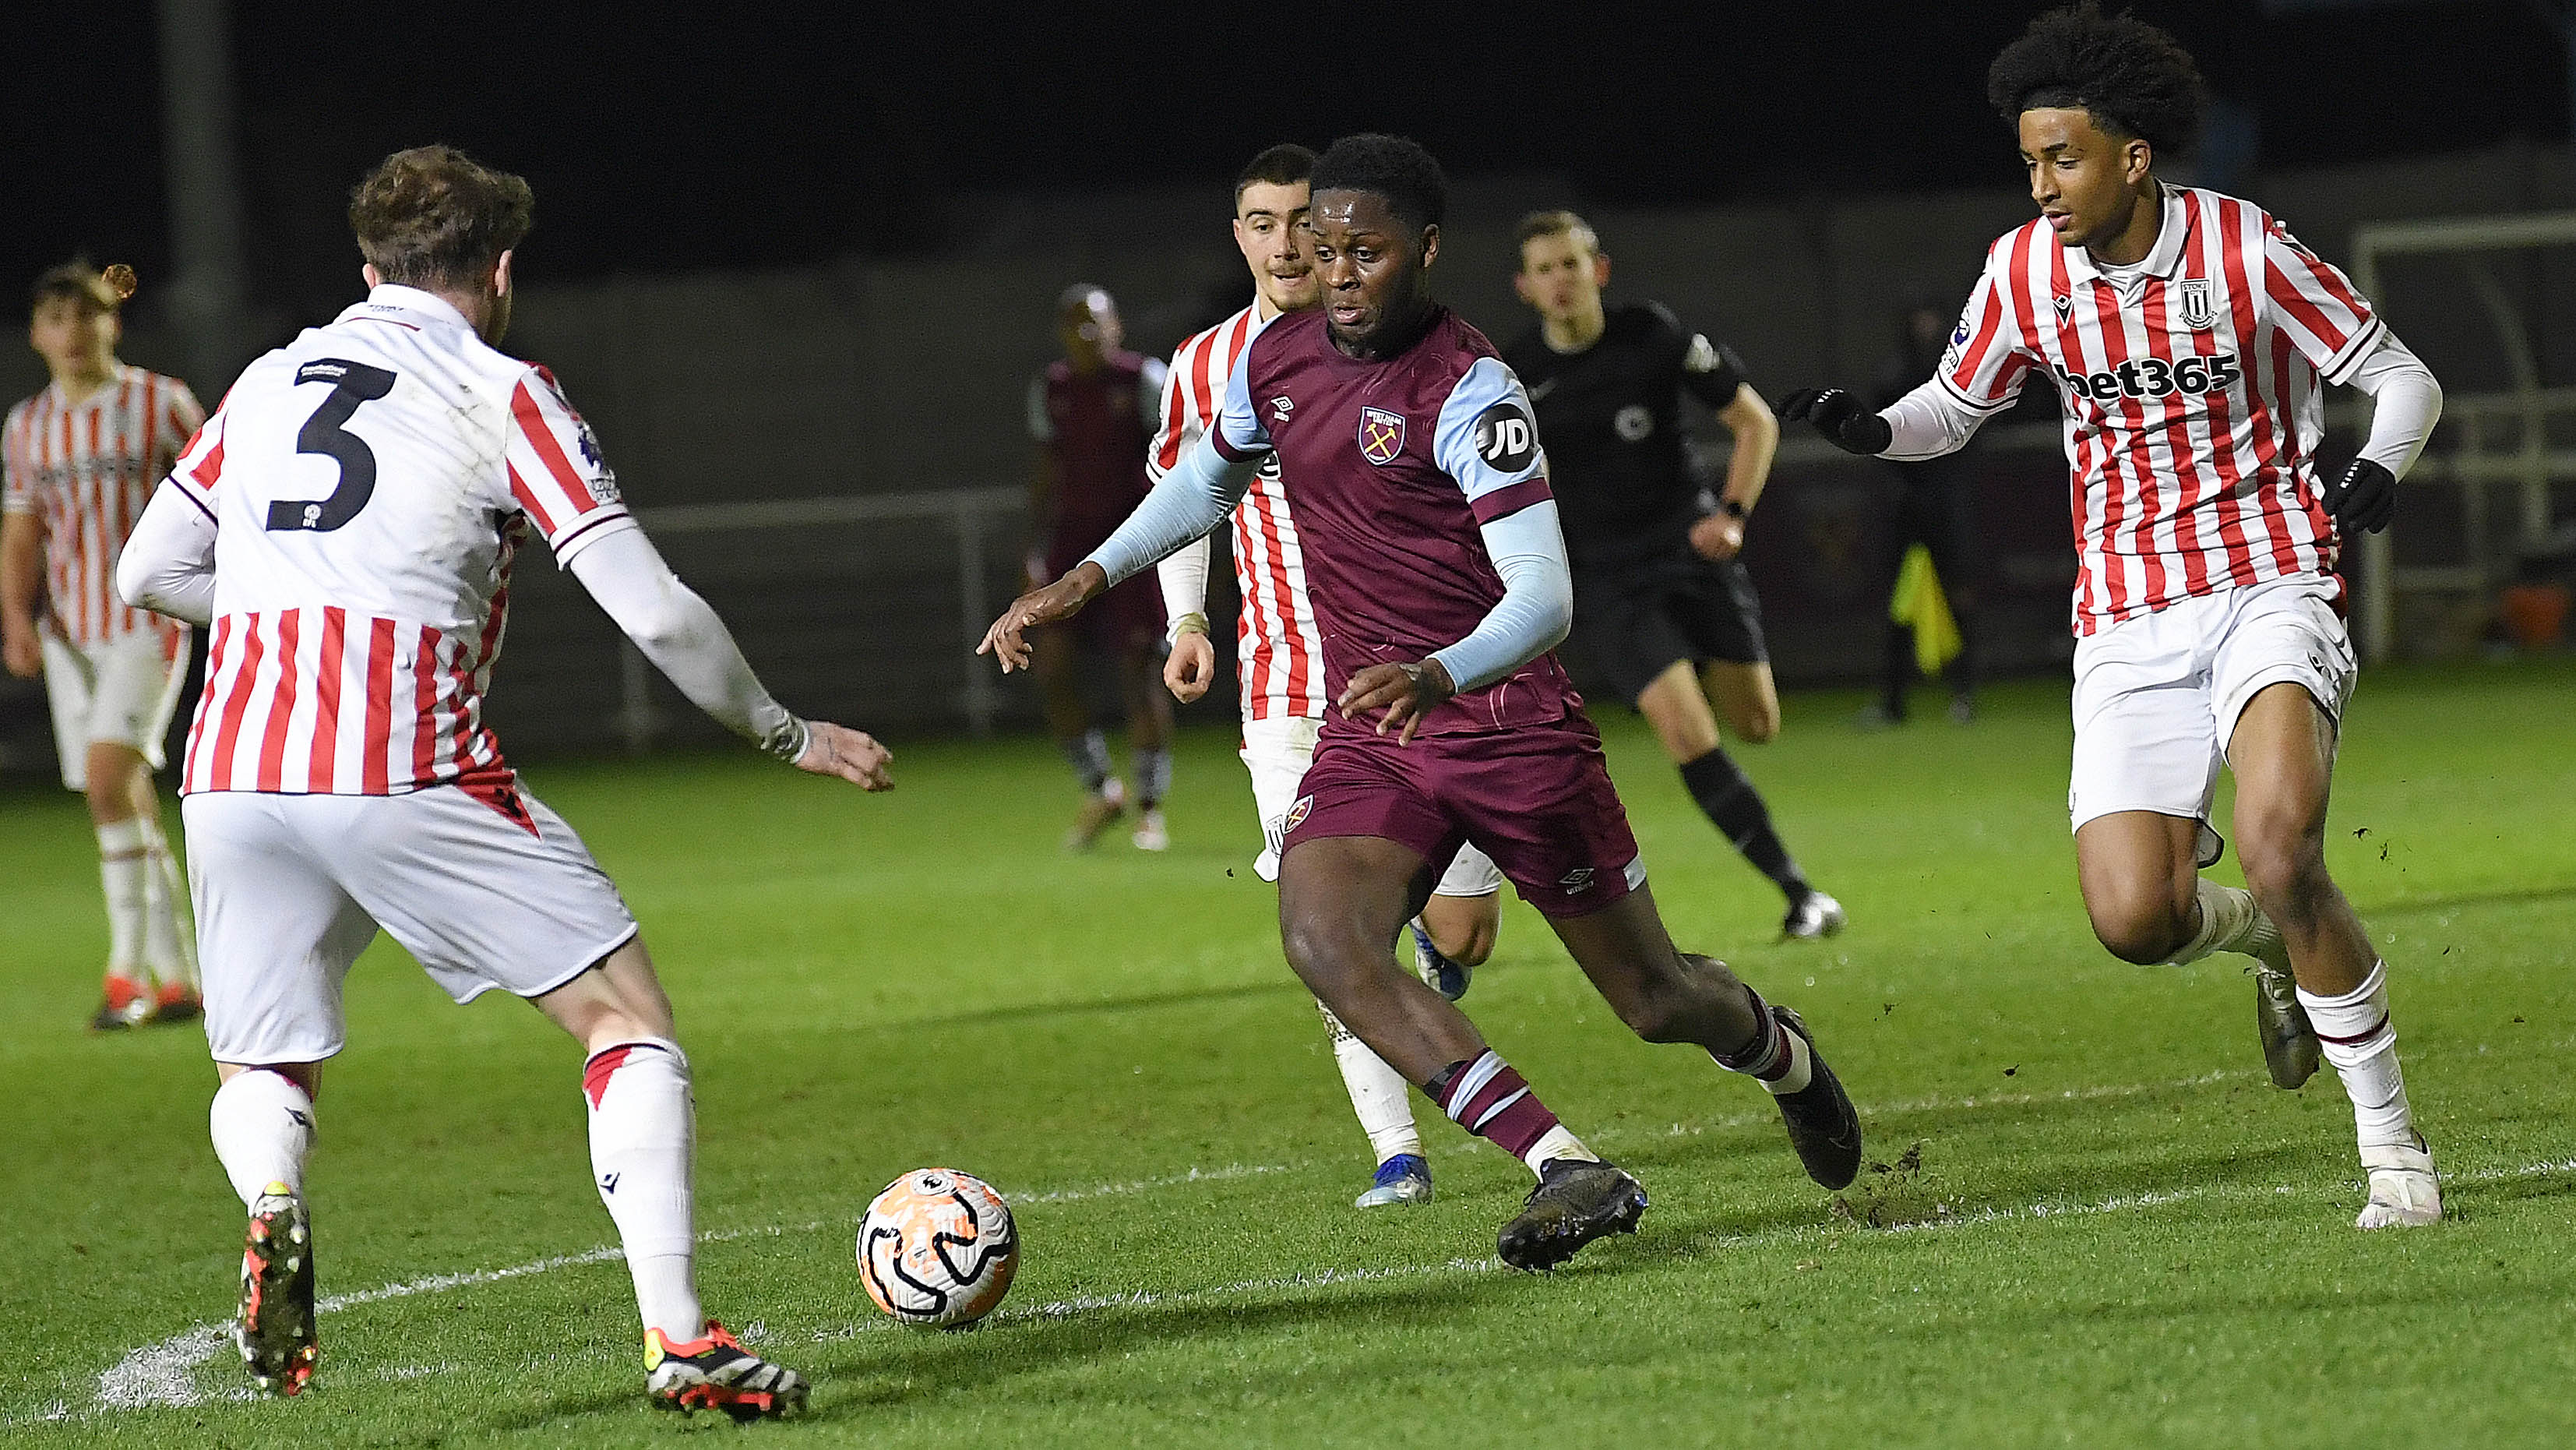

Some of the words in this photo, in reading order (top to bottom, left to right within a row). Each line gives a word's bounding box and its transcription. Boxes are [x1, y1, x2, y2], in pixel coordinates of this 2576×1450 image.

[2052, 353, 2241, 400] bet365
[266, 358, 397, 531] 3
[1487, 418, 1529, 460] JD
